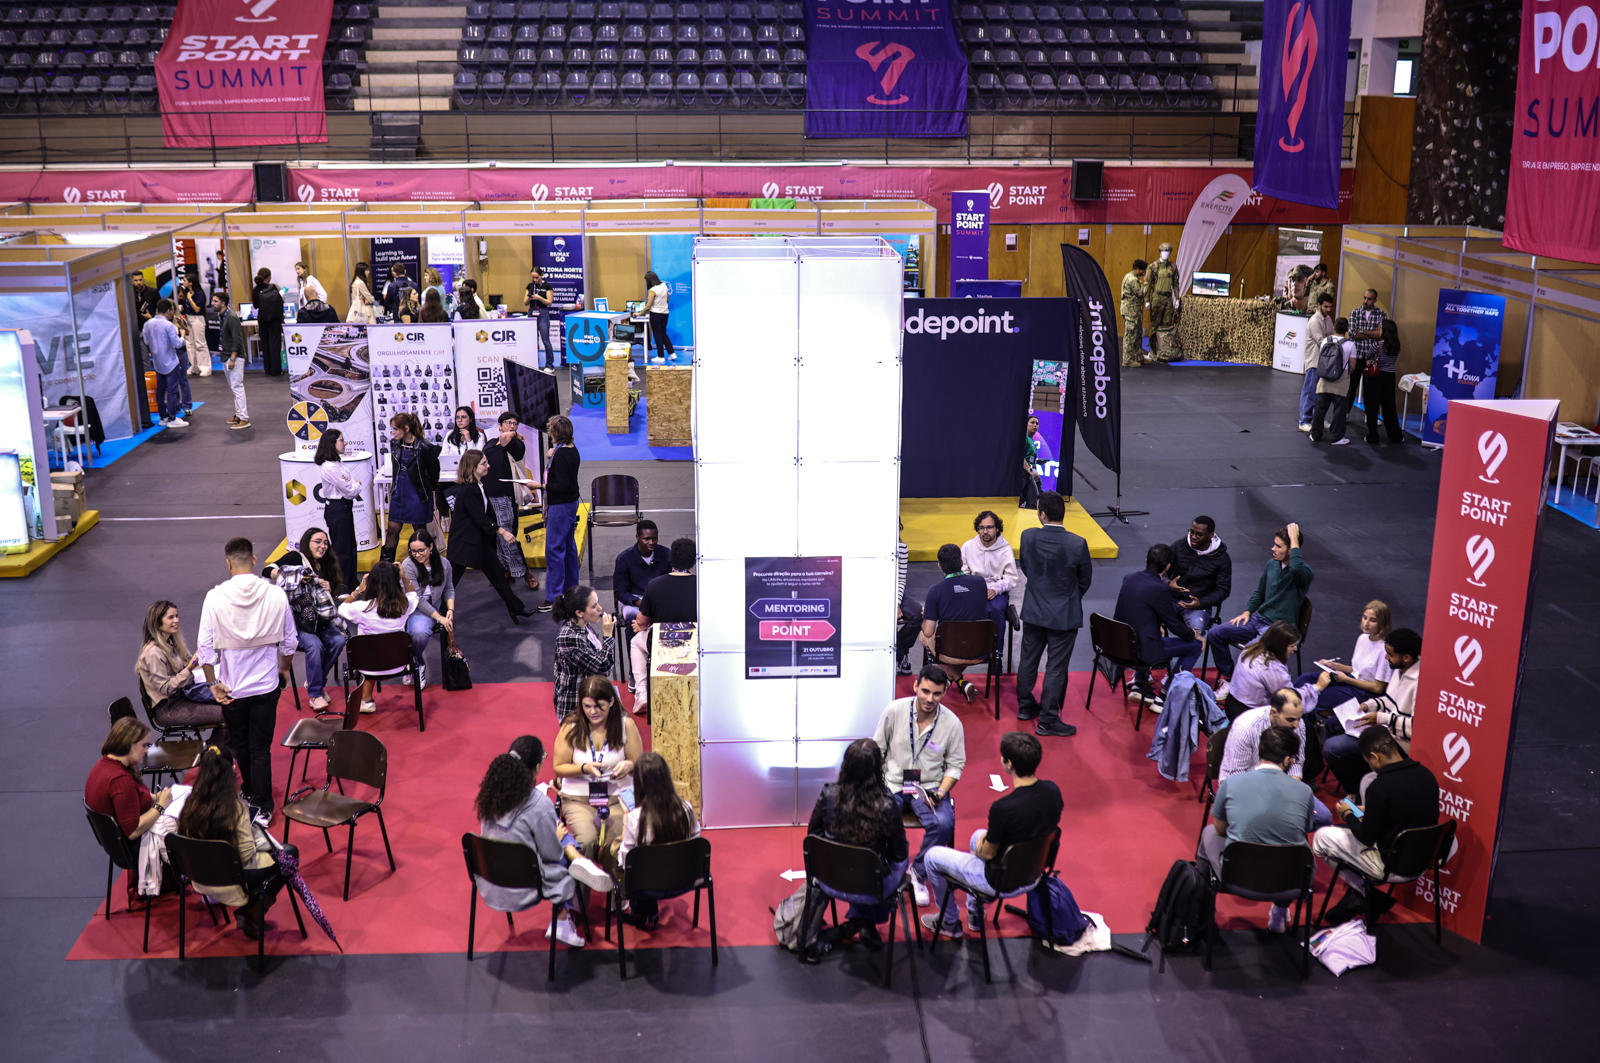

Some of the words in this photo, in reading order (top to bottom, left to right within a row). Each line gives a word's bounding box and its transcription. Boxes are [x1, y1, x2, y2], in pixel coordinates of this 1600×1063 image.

[816, 7, 940, 21] SUMMIT
[179, 34, 318, 50] START
[176, 49, 310, 62] POINT
[174, 66, 307, 90] SUMMIT
[86, 190, 127, 200] START
[320, 188, 360, 198] START
[554, 186, 594, 196] START
[785, 185, 824, 195] START
[1009, 186, 1047, 195] START
[1009, 196, 1045, 206] POINT
[1244, 197, 1263, 206] INT
[956, 213, 985, 221] START
[956, 221, 984, 229] POINT
[1304, 243, 1319, 251] LOCAL
[1456, 307, 1484, 315] TOGETHER
[905, 308, 1020, 340] depoint.
[406, 332, 425, 342] CJR
[491, 330, 516, 342] CJR
[35, 332, 94, 375] VE
[288, 346, 308, 356] CJR
[54, 373, 96, 385] constrção
[1462, 491, 1511, 514] START
[1460, 504, 1508, 527] POINT
[0, 537, 21, 545] nergy
[764, 604, 825, 613] MENTORING
[1450, 592, 1498, 617] START
[1449, 604, 1495, 629] POINT
[772, 625, 811, 636] POINT
[1439, 690, 1486, 716] START
[1438, 702, 1482, 728] POINT
[1438, 788, 1474, 812] TART
[1438, 800, 1470, 822] OINT
[1415, 886, 1458, 914] PONT
